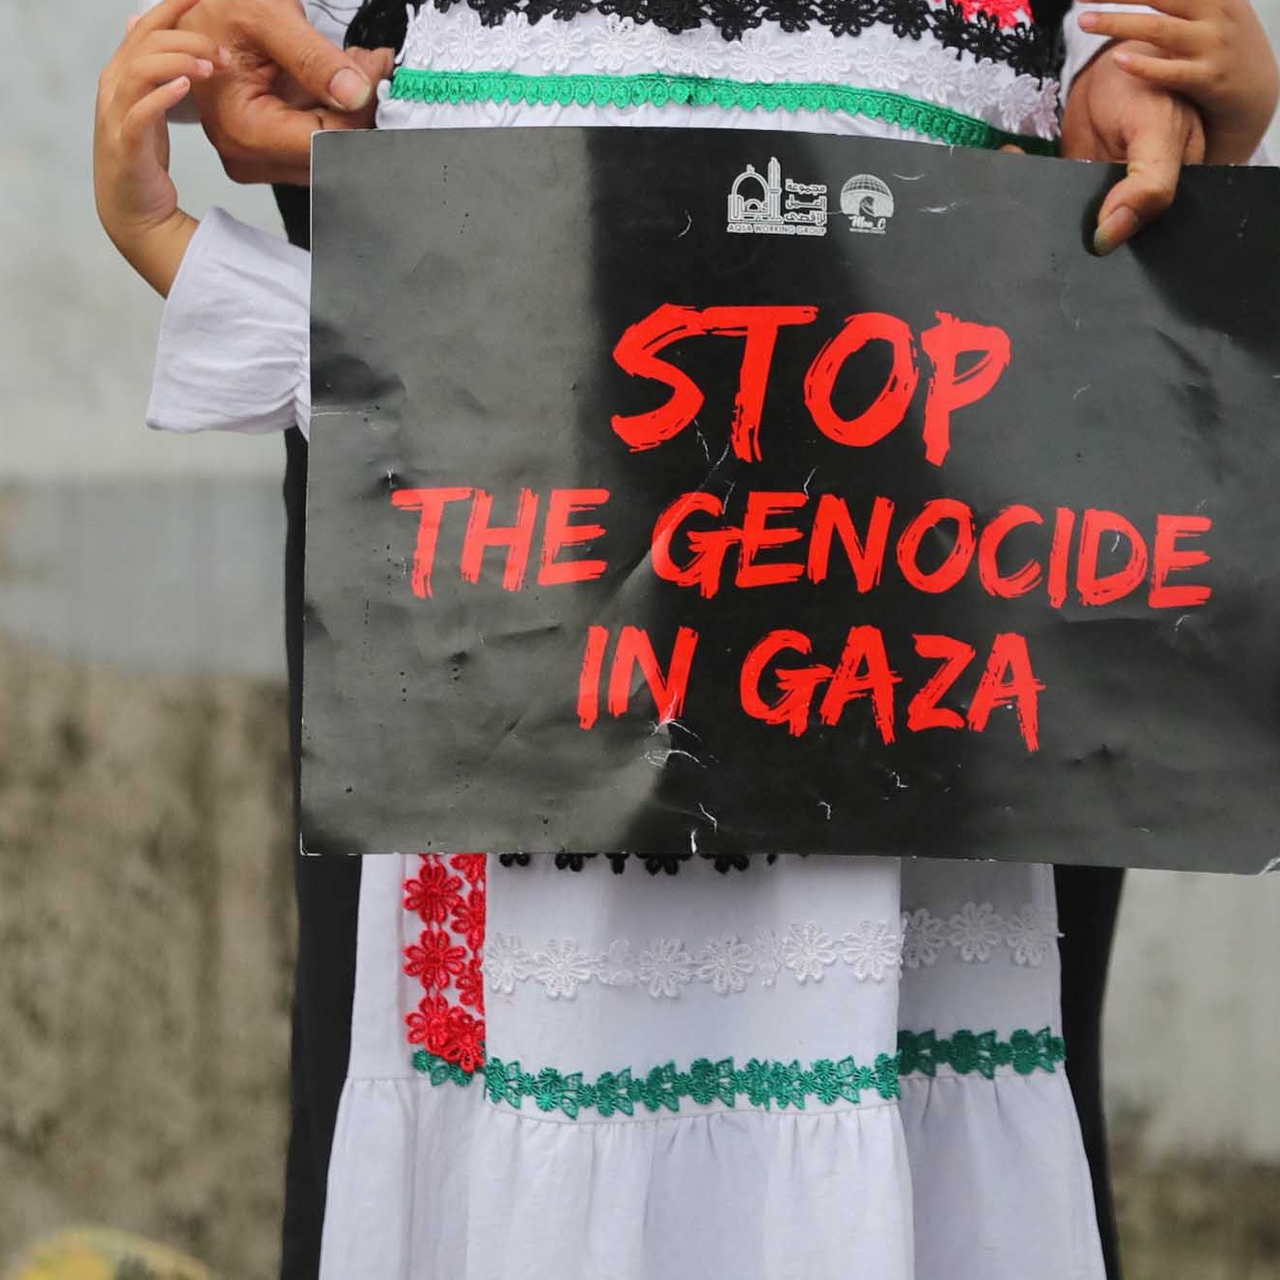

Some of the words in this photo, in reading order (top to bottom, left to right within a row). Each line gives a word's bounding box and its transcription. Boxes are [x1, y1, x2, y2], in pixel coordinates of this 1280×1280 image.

[727, 223, 753, 233] AQSA
[754, 223, 796, 234] WORKING
[796, 225, 827, 236] GROUP
[611, 303, 1012, 467] STOP
[391, 488, 610, 599] THE
[651, 491, 1213, 609] GENOCIDE
[576, 625, 699, 731] IN
[740, 624, 1047, 753] GAZA
